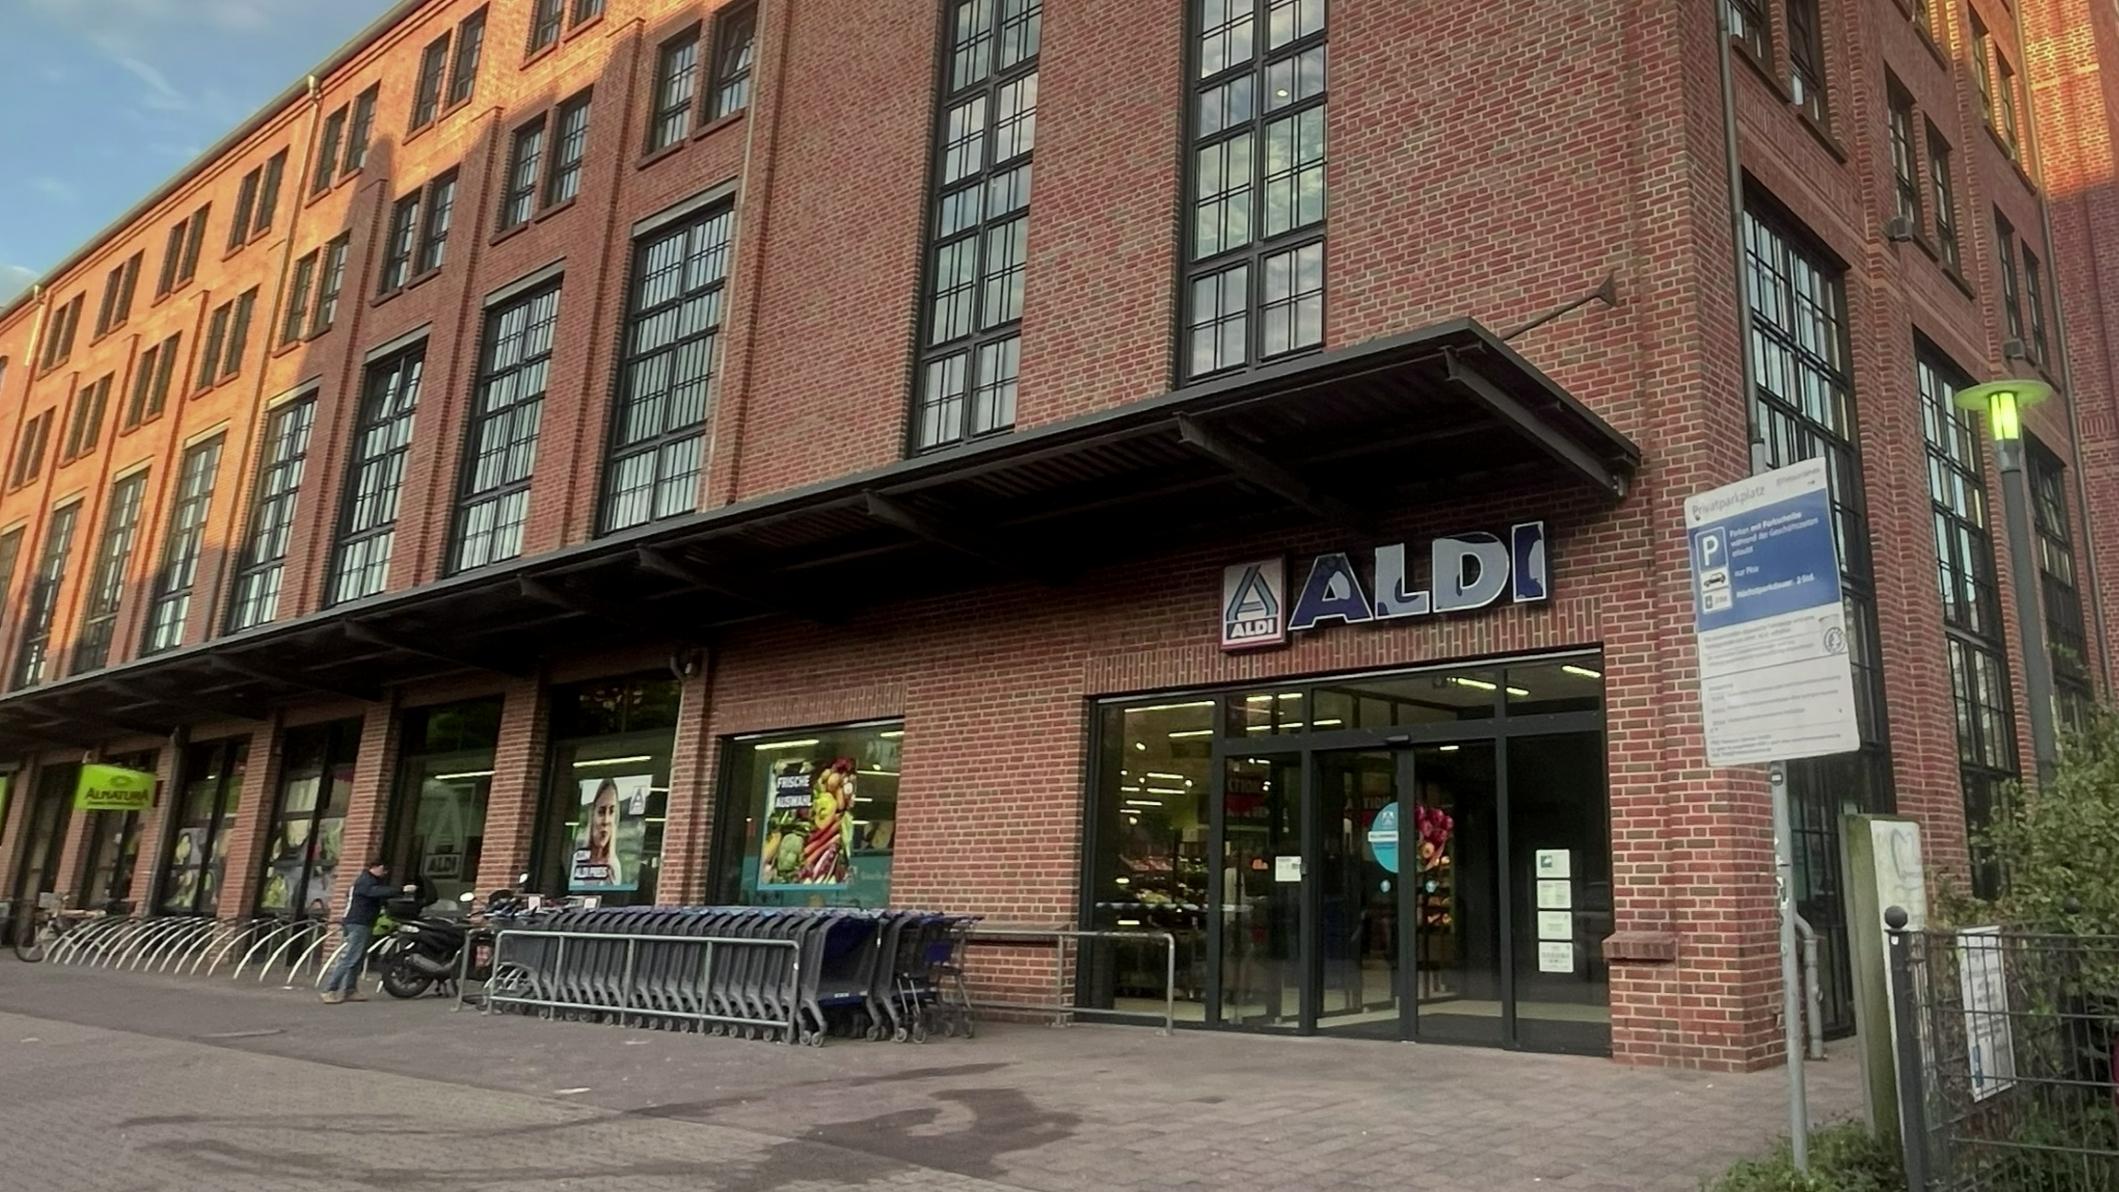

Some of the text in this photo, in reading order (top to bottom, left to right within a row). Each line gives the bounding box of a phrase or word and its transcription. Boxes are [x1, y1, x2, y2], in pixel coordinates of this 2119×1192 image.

[1692, 486, 1765, 514] Privatparkplatz
[1702, 534, 1720, 566] P
[1287, 521, 1547, 631] ALDI
[1230, 619, 1274, 638] ALDI
[777, 775, 810, 788] FRISCHE
[85, 787, 149, 801] ALNATURA
[429, 856, 457, 872] ALDI
